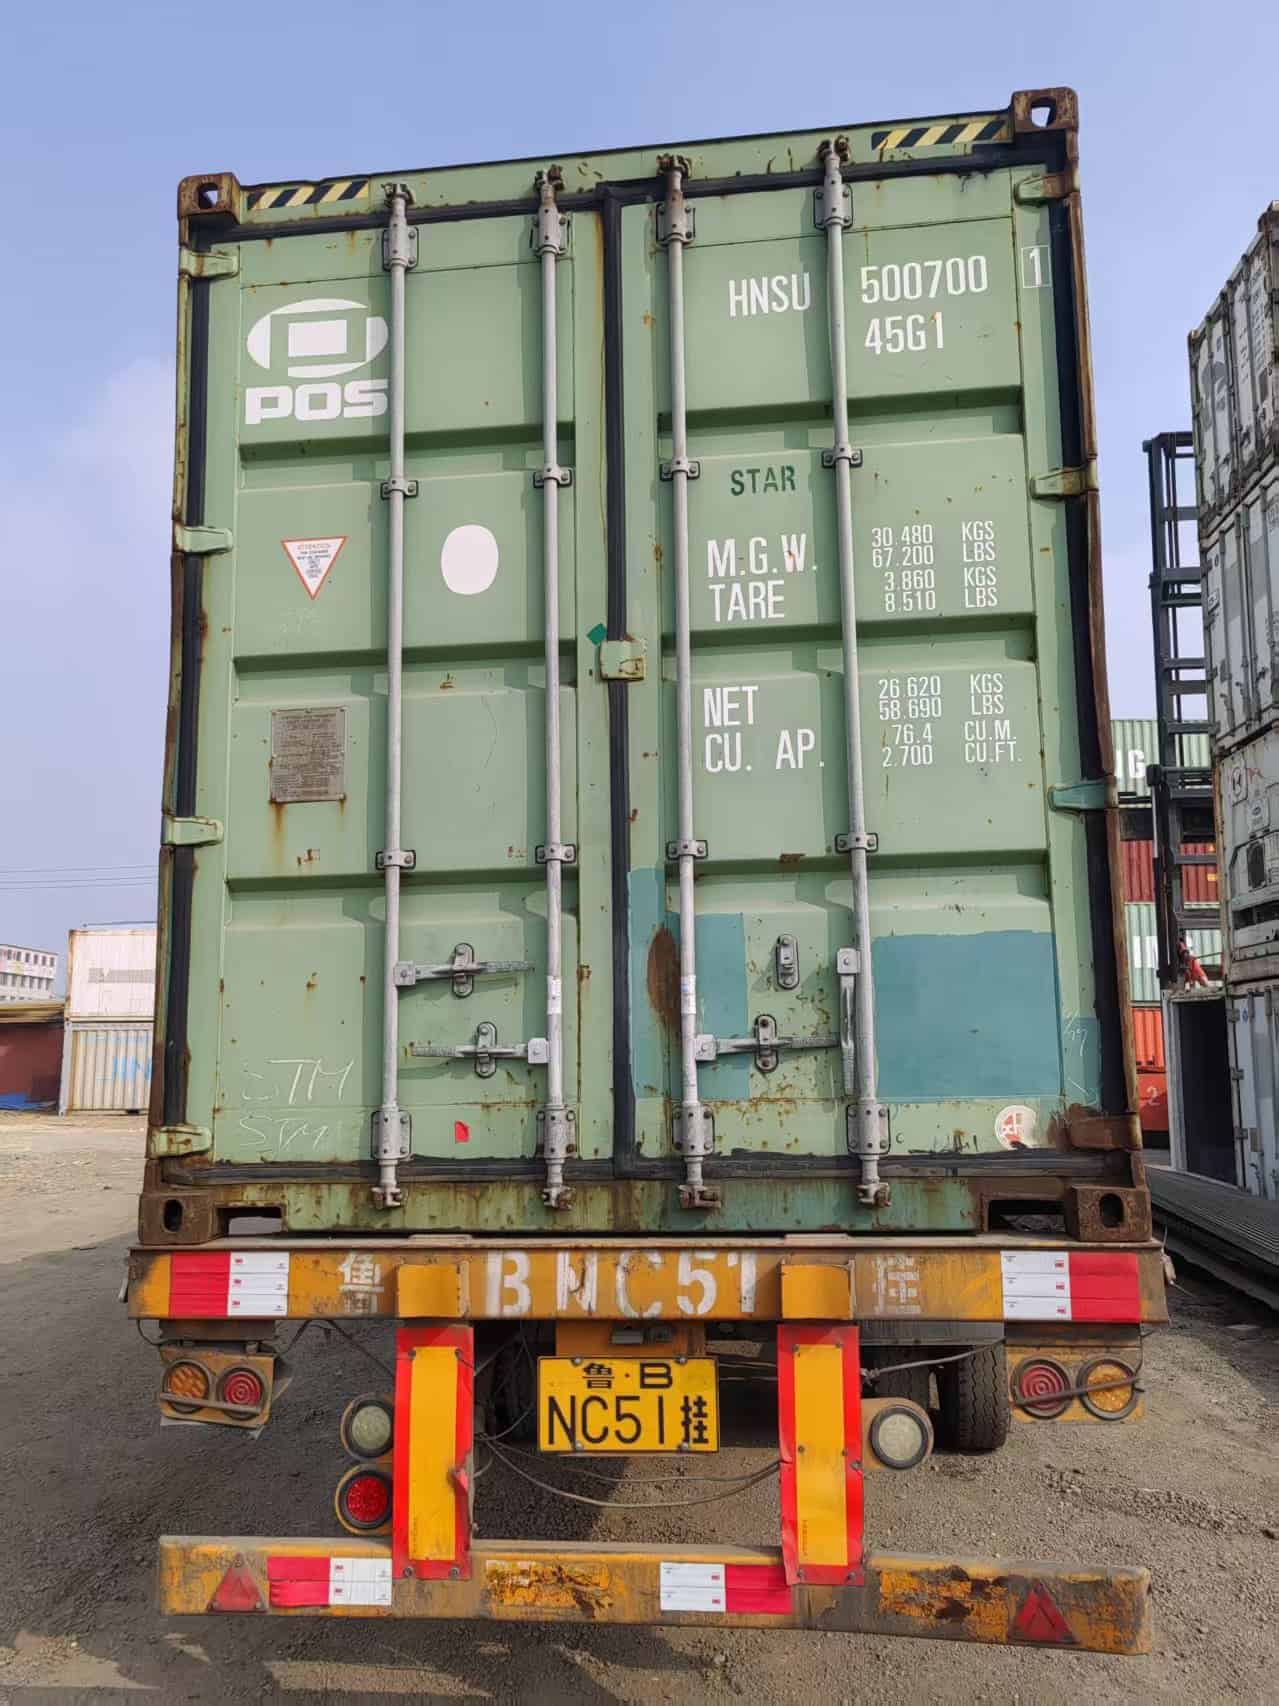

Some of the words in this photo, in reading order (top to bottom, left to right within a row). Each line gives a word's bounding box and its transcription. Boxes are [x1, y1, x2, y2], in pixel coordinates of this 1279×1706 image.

[729, 273, 811, 318] HNSU
[861, 256, 989, 304] 500700
[1030, 248, 1042, 287] 1
[865, 313, 944, 354] 45G1
[245, 378, 389, 425] POS
[731, 465, 796, 496] STAR
[872, 525, 933, 549] 30.480
[962, 521, 995, 541] KGS
[707, 534, 818, 578] M.G.W.
[872, 545, 934, 569] 67.200
[962, 542, 996, 563] LBS
[884, 569, 935, 591] 3.860
[964, 566, 998, 587] KGS
[709, 580, 786, 622] TARE
[885, 590, 936, 612] 8.510
[965, 587, 998, 608] LBS
[879, 676, 941, 699] 26.620
[970, 673, 1004, 693] KGS
[704, 686, 759, 727] NET
[879, 697, 942, 721] 58.690
[971, 694, 1005, 715] LBS
[892, 723, 933, 745] 76.4
[964, 720, 1017, 742] CU.M.
[705, 732, 753, 773] CU.
[775, 728, 825, 770] AP.
[883, 744, 934, 767] 2.700
[965, 740, 1023, 763] CU.FT.
[548, 1395, 709, 1447] NC51挂
